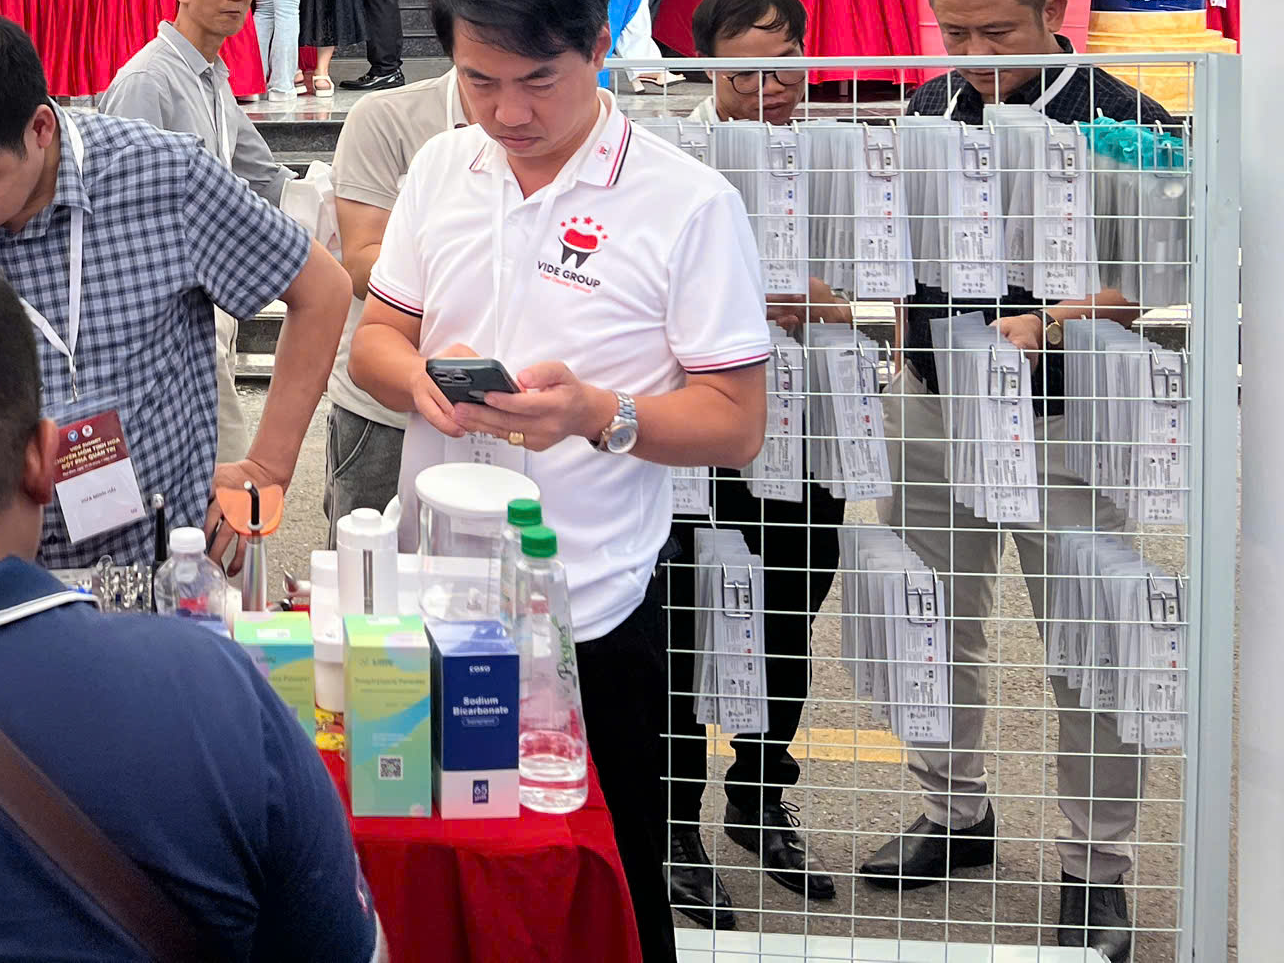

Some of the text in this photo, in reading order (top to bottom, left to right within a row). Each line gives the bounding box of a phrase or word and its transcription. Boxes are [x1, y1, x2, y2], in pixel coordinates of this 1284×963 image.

[537, 260, 601, 288] VIDE GROUP
[462, 696, 499, 706] Sodium
[452, 705, 509, 716] Bicarbonate
